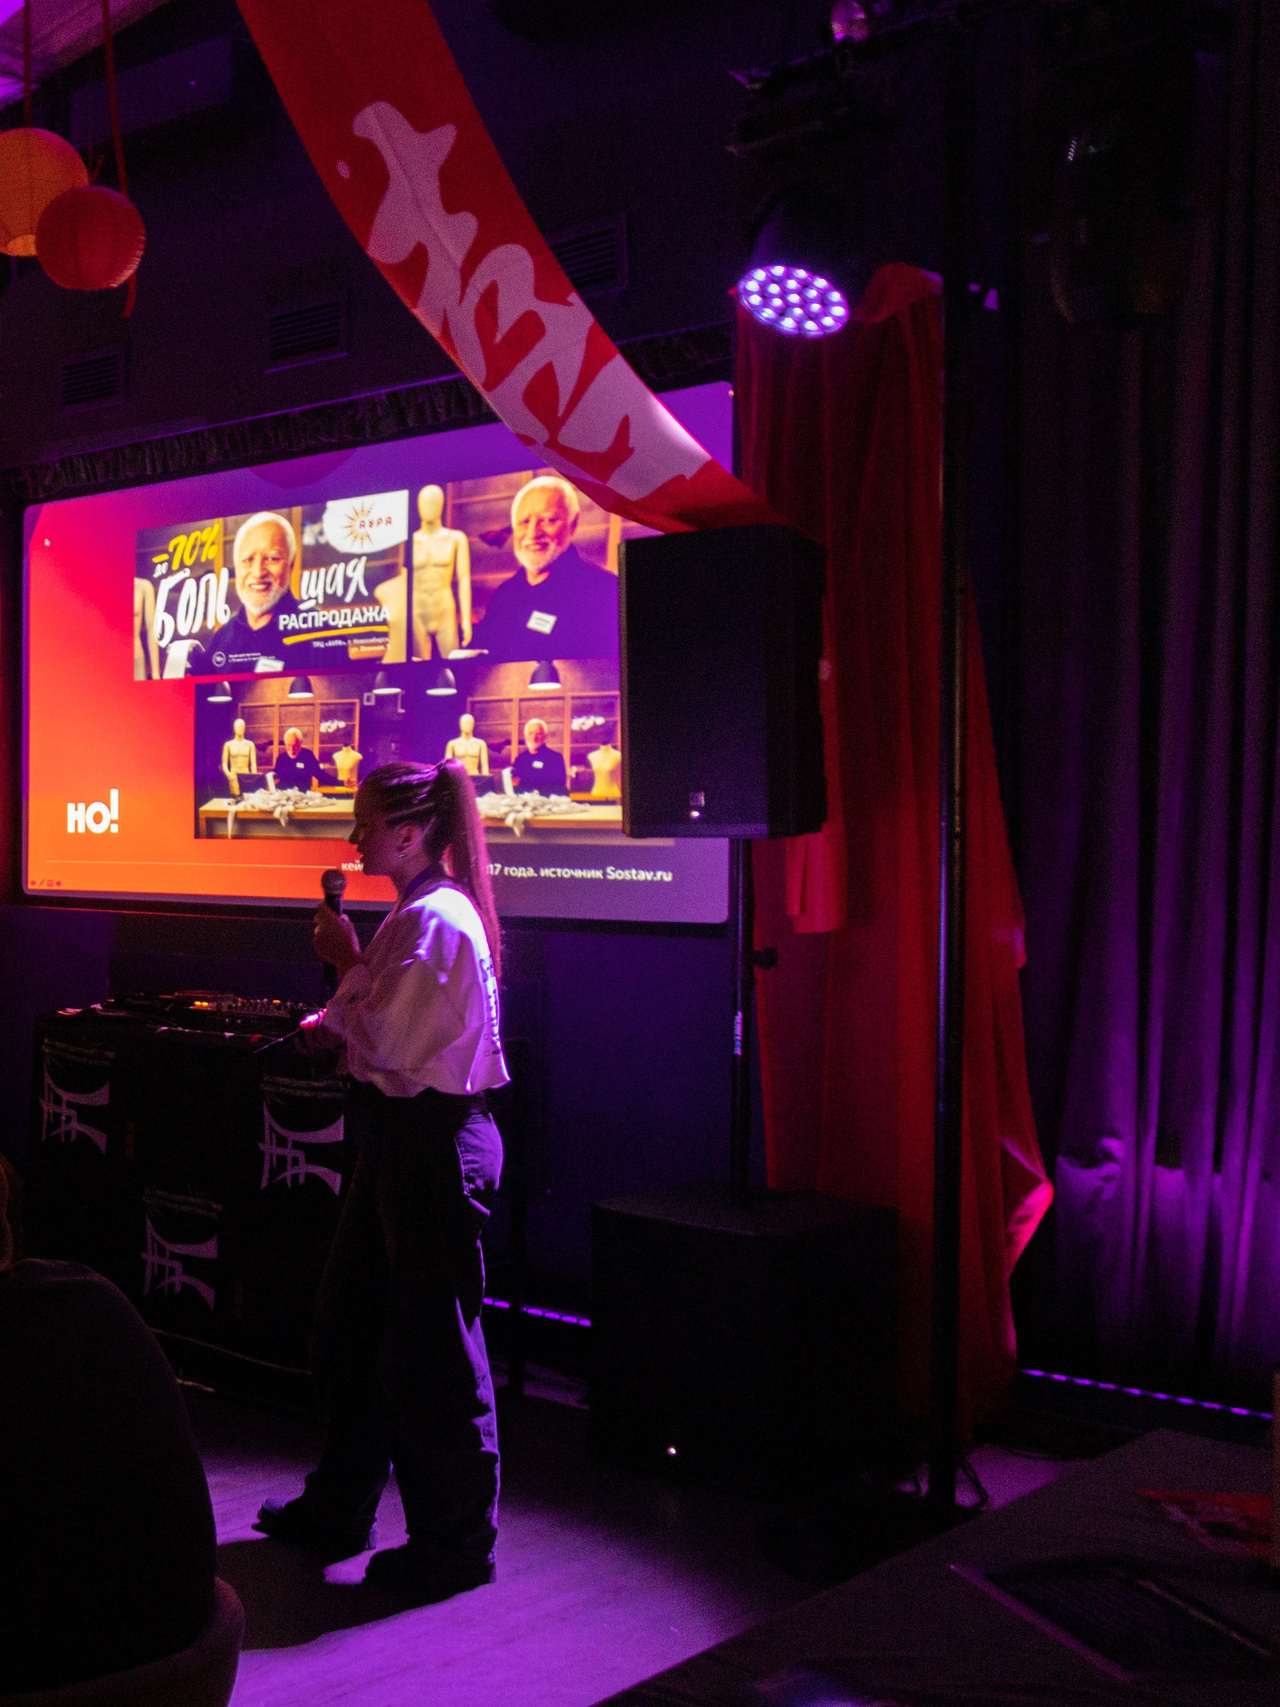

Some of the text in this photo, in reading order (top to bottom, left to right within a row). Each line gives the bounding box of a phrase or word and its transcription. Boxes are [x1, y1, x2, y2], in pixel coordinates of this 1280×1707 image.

[278, 605, 391, 631] РАСПРОДАЖА
[503, 866, 538, 878] года.
[540, 867, 604, 879] источник
[606, 866, 673, 882] Sostav.ru
